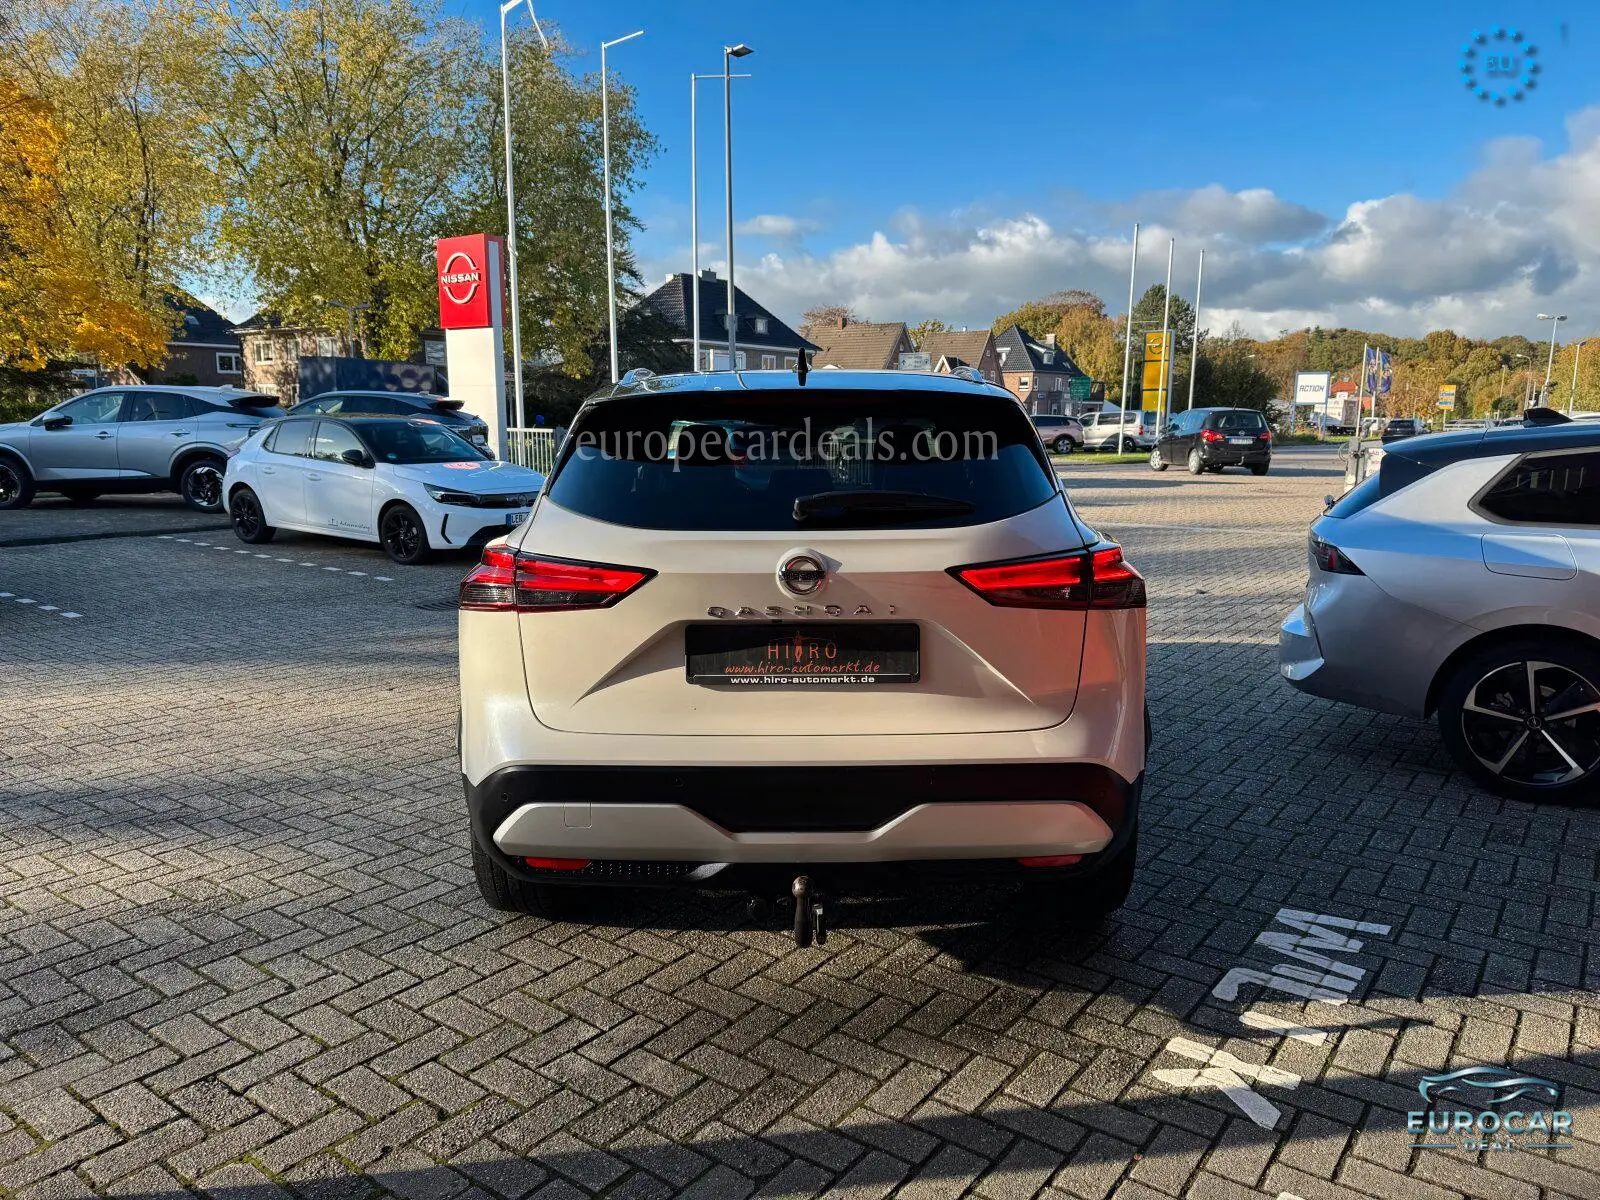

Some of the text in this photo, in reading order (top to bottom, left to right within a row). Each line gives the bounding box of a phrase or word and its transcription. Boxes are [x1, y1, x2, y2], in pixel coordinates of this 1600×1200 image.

[441, 271, 480, 284] NISSAN
[1298, 384, 1326, 393] ACTION
[706, 605, 896, 619] QASHQAI
[724, 660, 881, 674] www.hiro-automarkt.de
[730, 675, 875, 684] www.hiro-automarkt.de
